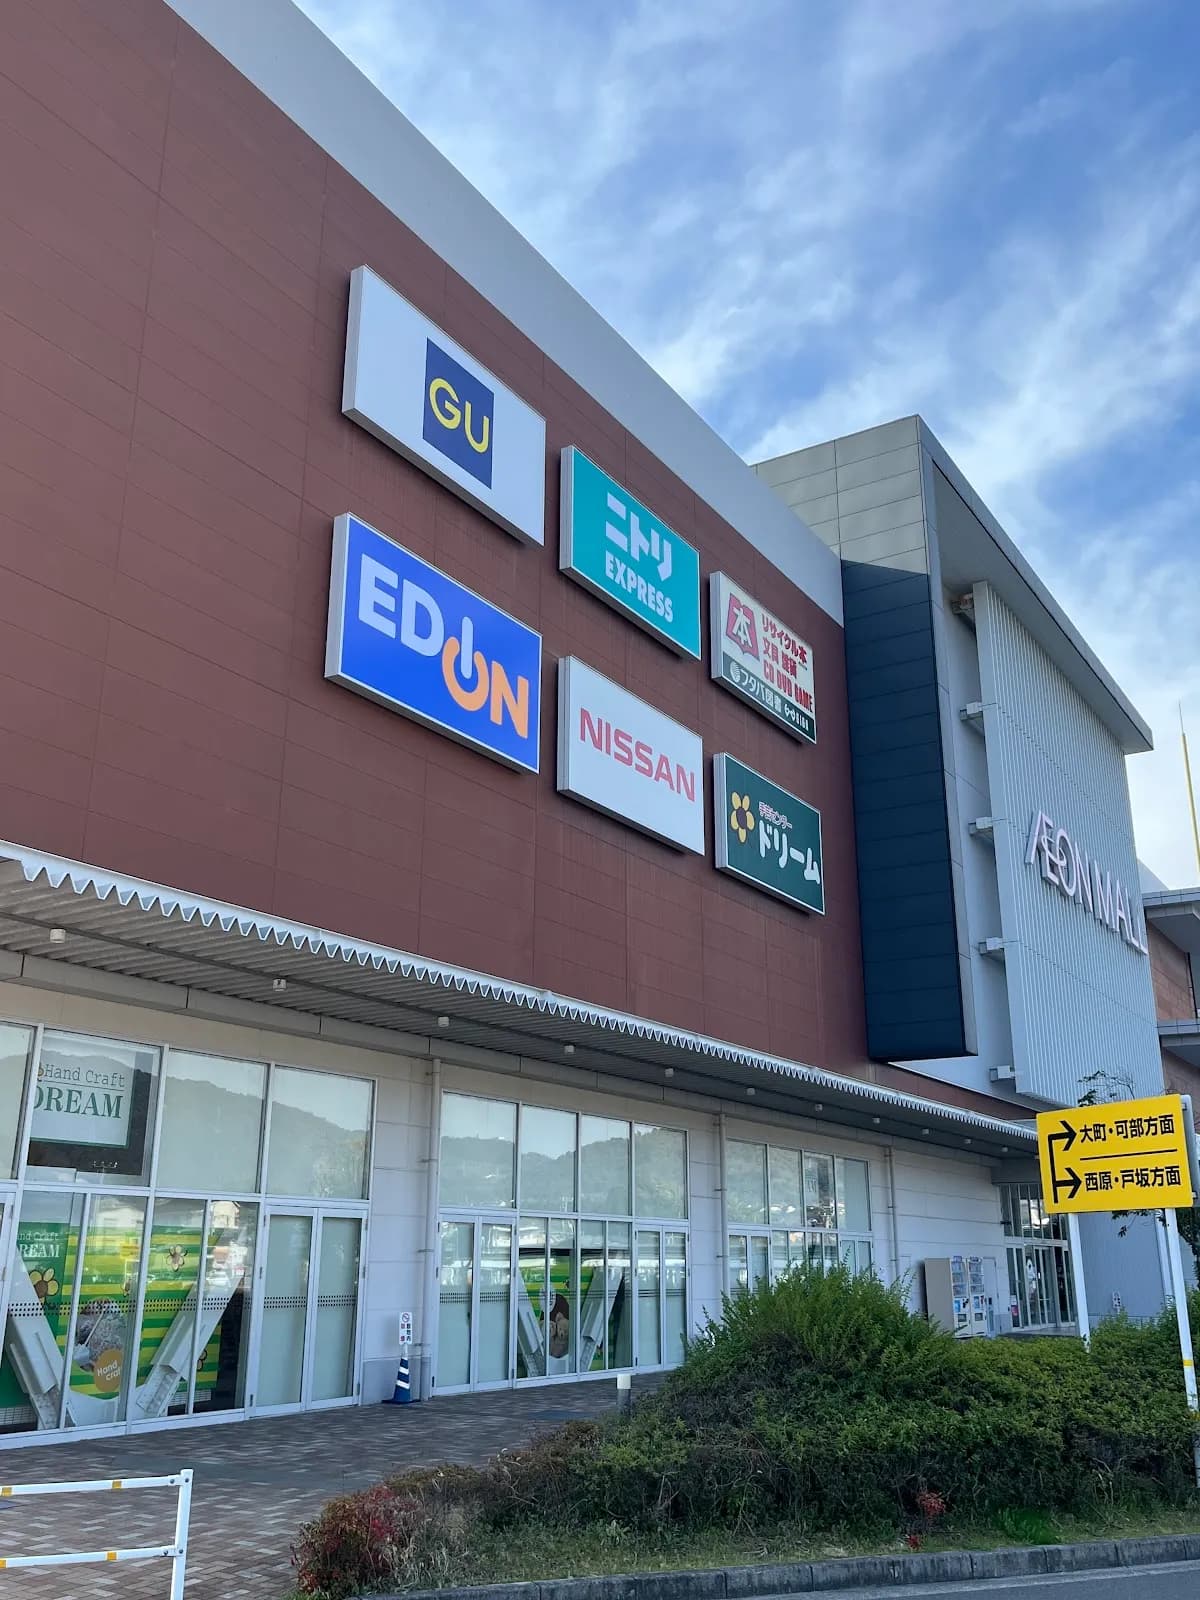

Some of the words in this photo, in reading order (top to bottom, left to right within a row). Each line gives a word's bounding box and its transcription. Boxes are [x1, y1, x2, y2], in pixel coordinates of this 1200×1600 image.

[428, 377, 490, 454] GU
[605, 492, 672, 582] ニトリ
[605, 550, 674, 623] EXPRESS
[358, 553, 530, 740] EDION
[761, 613, 808, 665] リサイクル本
[741, 670, 782, 713] フタバ図書
[763, 658, 775, 684] CD
[777, 670, 793, 698] DVD
[795, 683, 814, 713] GAME
[580, 707, 696, 802] NISSAN
[758, 820, 821, 885] ドリーム
[1094, 859, 1148, 955] MALL
[44, 1064, 81, 1081] Hand
[85, 1069, 125, 1087] Craft
[1079, 1114, 1175, 1143] 大町・可部方面
[1084, 1165, 1182, 1192] 西原・戸坂方面
[19, 1243, 60, 1258] REAM
[97, 1360, 118, 1377] Hand
